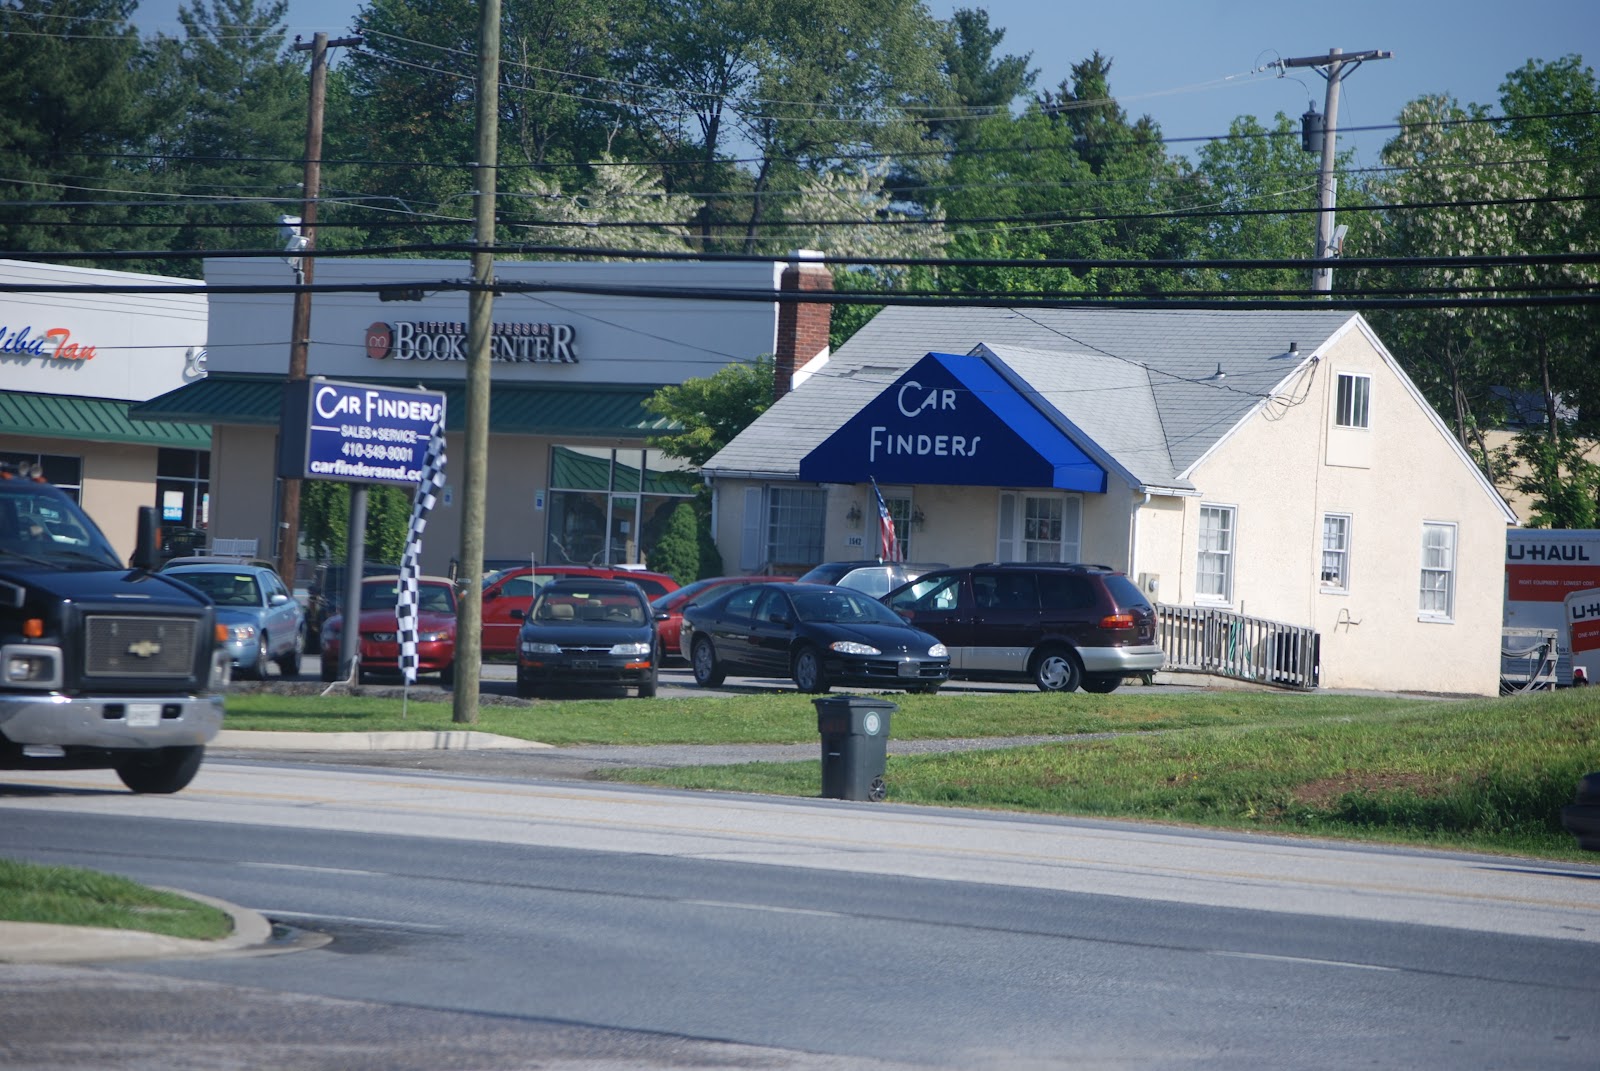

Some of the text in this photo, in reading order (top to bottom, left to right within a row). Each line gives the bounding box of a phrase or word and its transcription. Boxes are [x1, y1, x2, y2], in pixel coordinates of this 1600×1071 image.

[47, 328, 96, 360] Tan
[393, 322, 575, 363] BOOK ENTER
[415, 321, 550, 336] LITTLE OFESSOR
[316, 386, 442, 423] CAR FINDERS
[898, 381, 956, 417] CAR
[870, 426, 981, 462] FINDERS
[1507, 544, 1590, 561] U-HAUL
